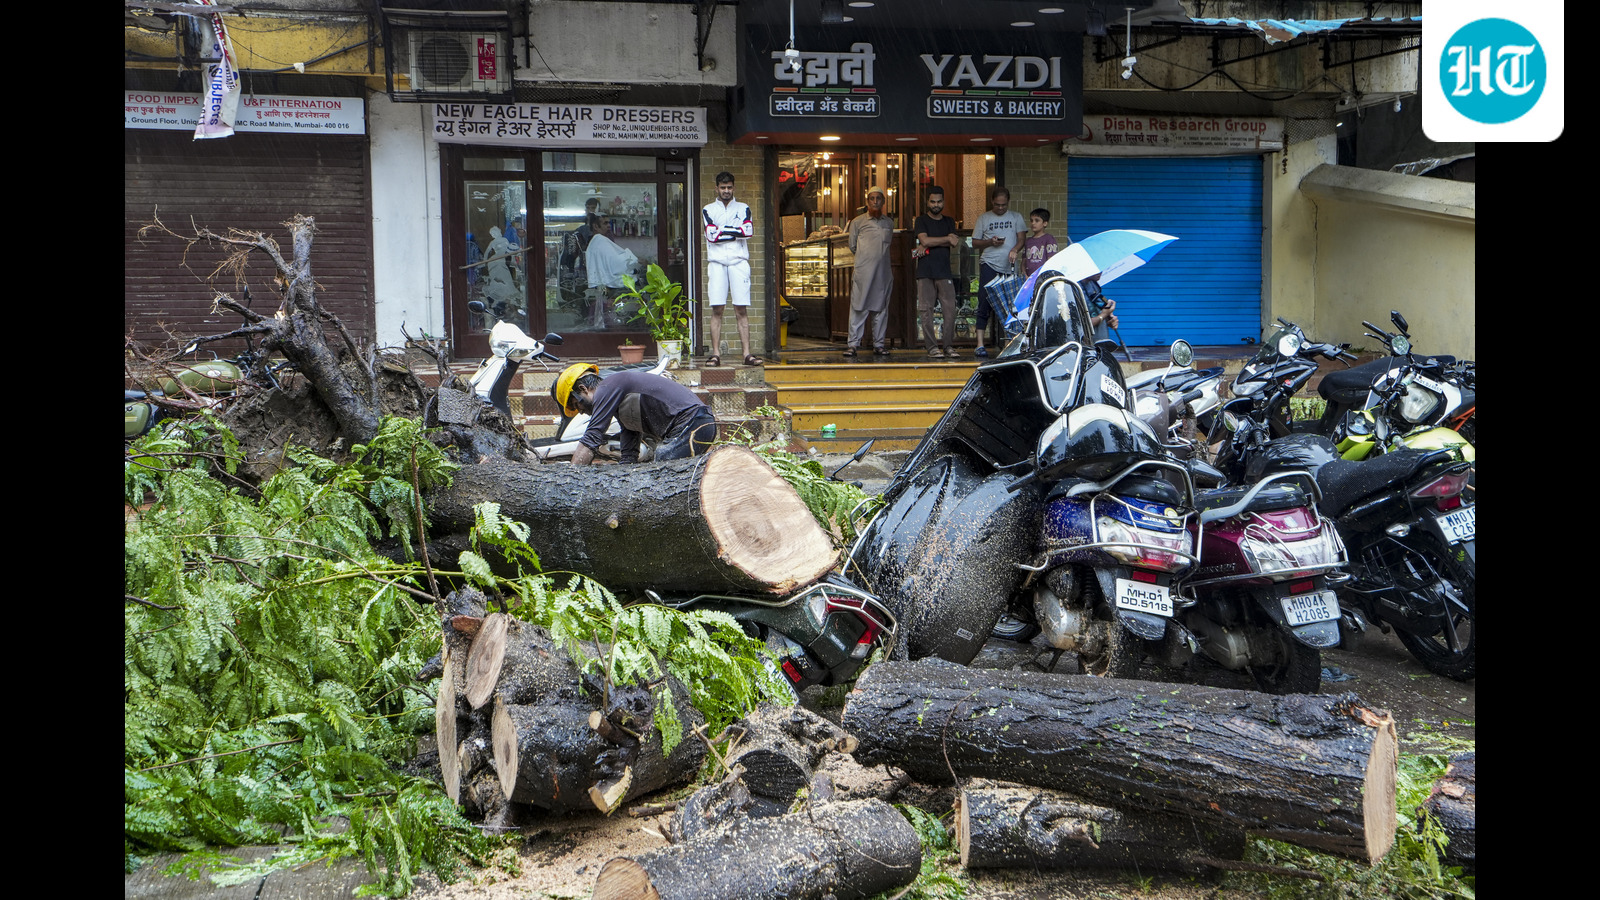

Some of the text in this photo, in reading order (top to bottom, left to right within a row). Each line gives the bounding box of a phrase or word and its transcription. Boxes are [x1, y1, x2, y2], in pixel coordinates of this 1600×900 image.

[920, 54, 1062, 89] YAZDI
[128, 94, 199, 105] FOOD IMPEX
[243, 98, 342, 109] U&F INTERNATION
[842, 97, 876, 112] बेकरी
[933, 99, 1061, 115] SWEETS & BAKERY
[264, 109, 280, 118] आणि
[282, 110, 293, 118] एफ
[436, 104, 695, 123] NEW EAGLE HAIR DRESSERS
[458, 118, 492, 136] ईगल
[497, 119, 532, 137] हेअर
[537, 120, 577, 138] ड्रेसर्स
[1103, 117, 1267, 135] Disha Research Group
[1127, 588, 1163, 602] MH.01
[1291, 595, 1326, 611] MH04K
[1121, 596, 1168, 612] DD.5118
[1295, 608, 1330, 623] H2085
